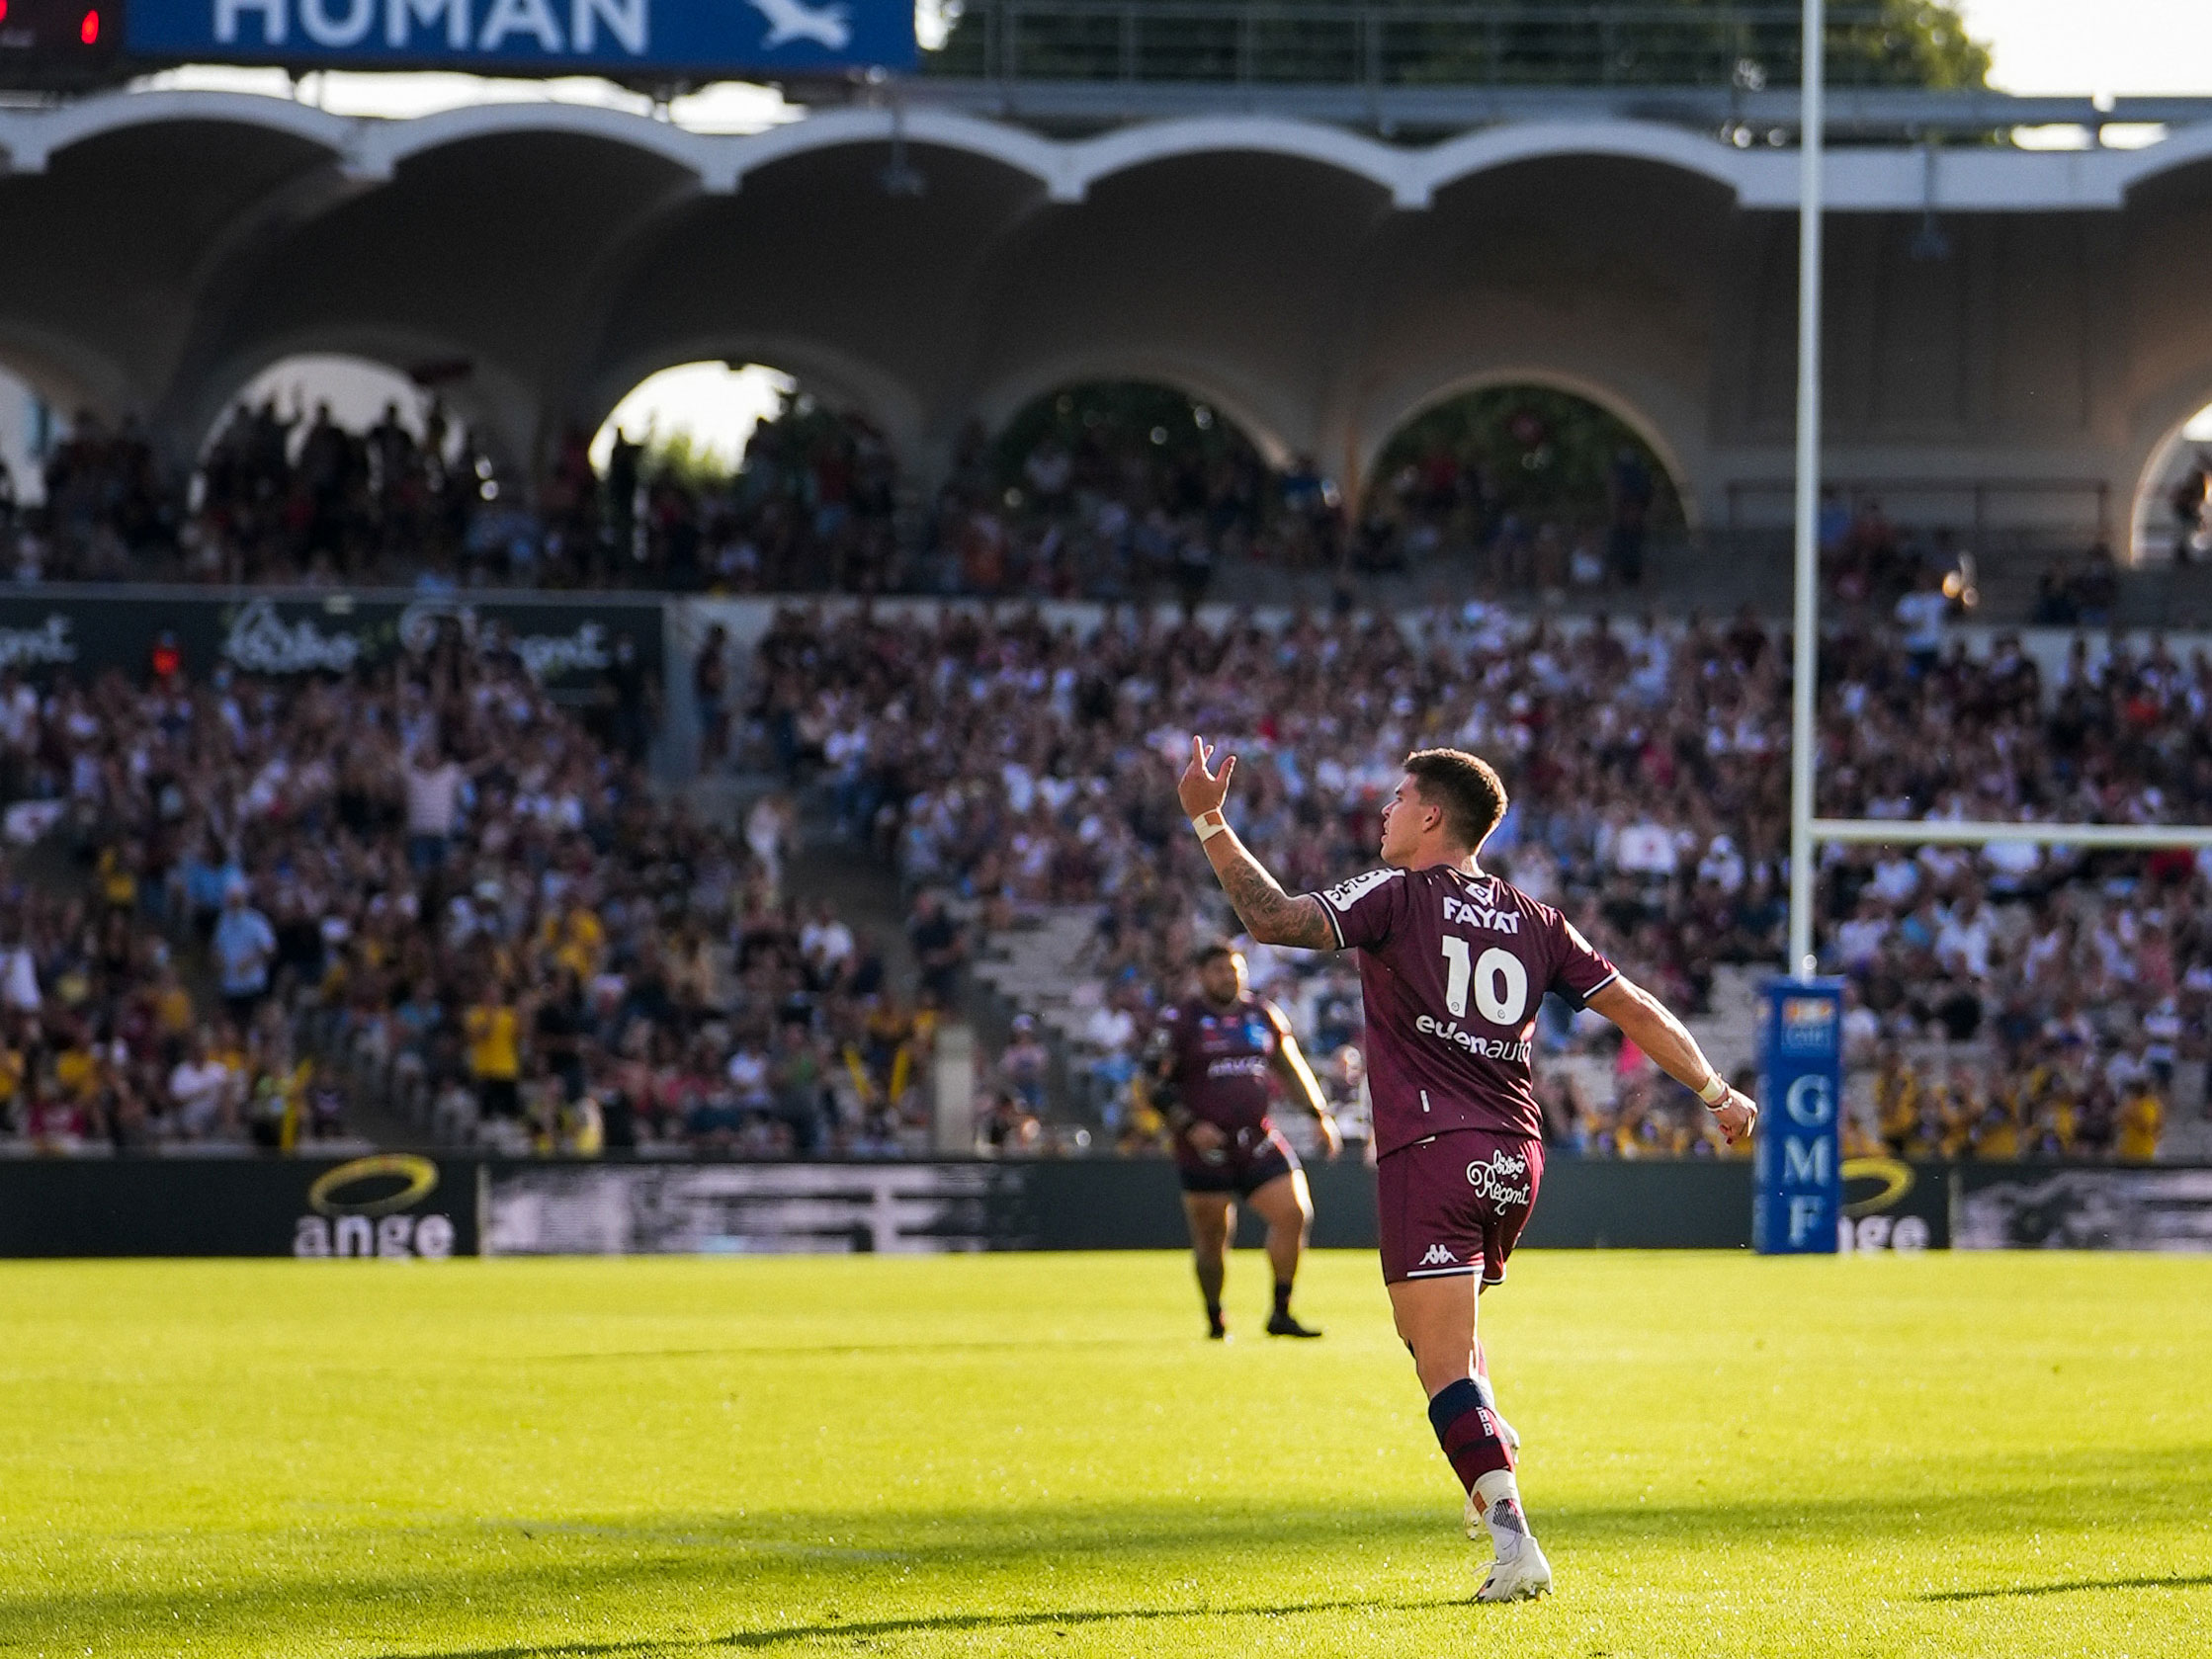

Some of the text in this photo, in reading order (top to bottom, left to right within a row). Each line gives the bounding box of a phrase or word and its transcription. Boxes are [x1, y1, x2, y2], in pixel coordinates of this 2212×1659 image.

[1443, 896, 1520, 935] FAYAT
[1441, 935, 1528, 1026] 10
[294, 1214, 454, 1259] ange
